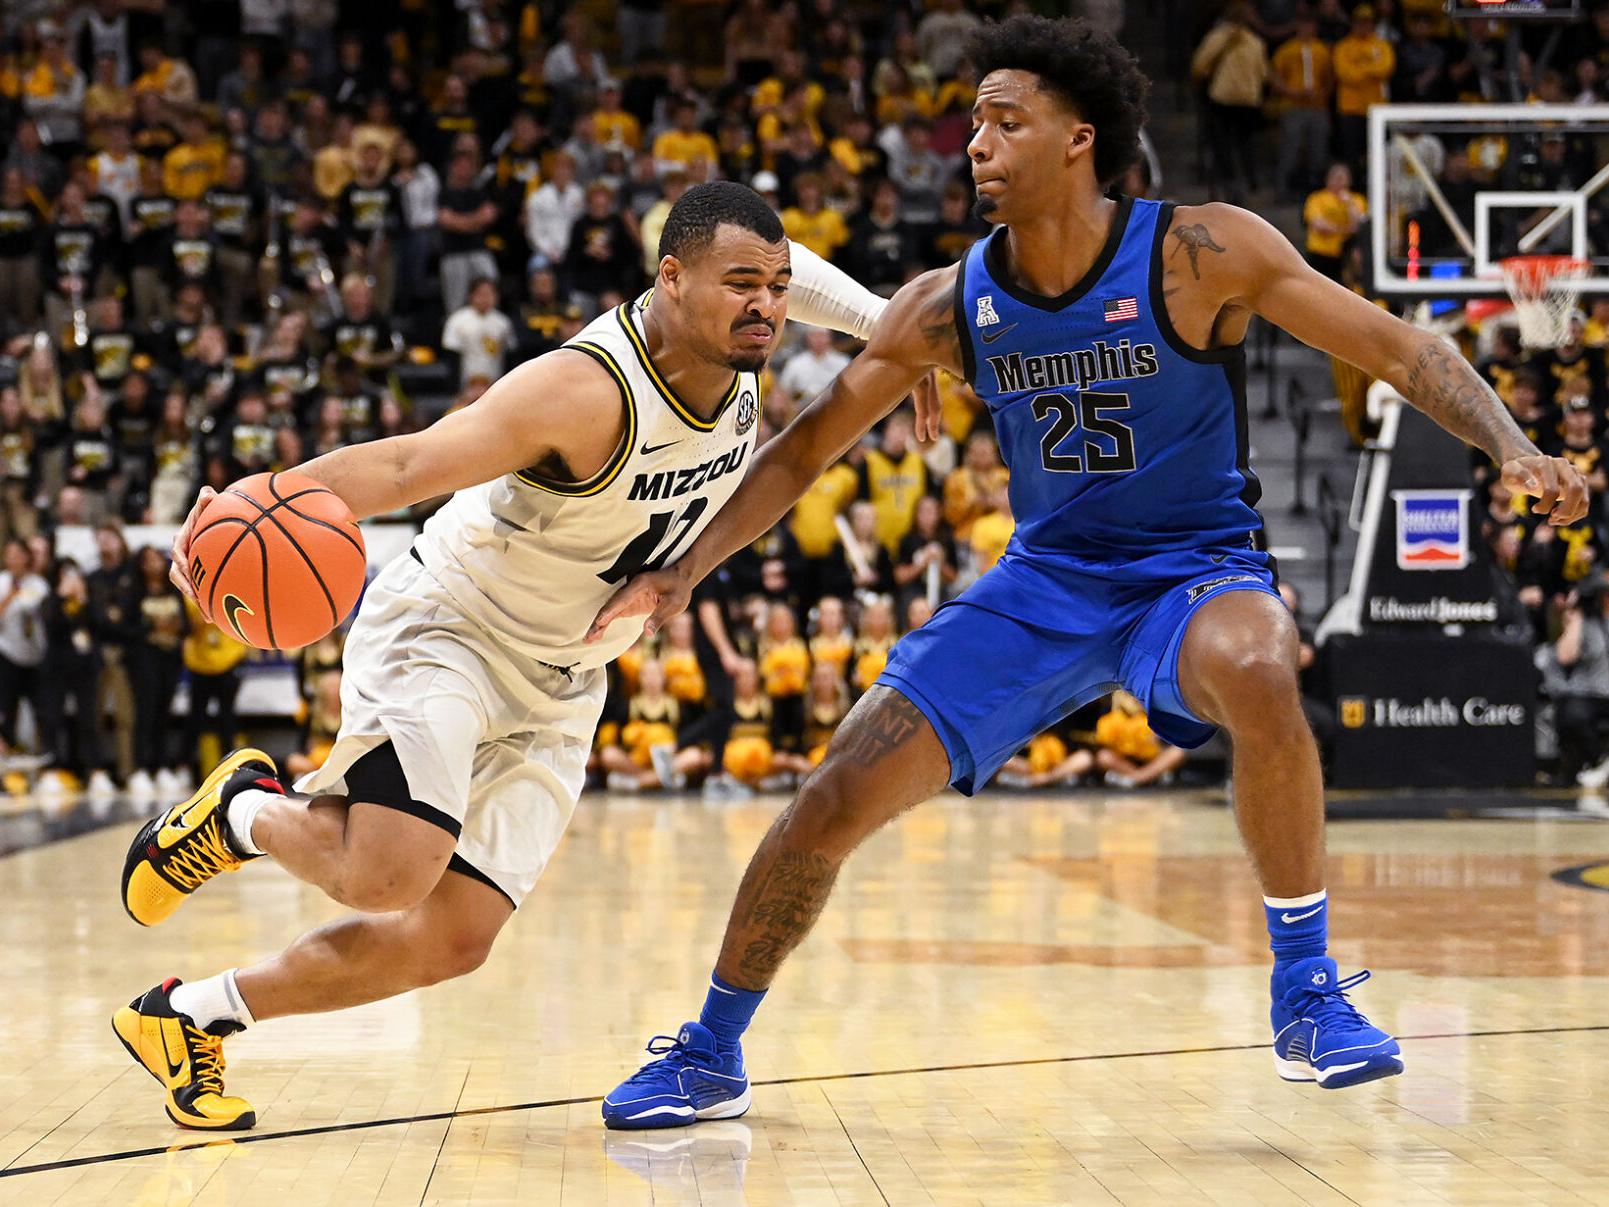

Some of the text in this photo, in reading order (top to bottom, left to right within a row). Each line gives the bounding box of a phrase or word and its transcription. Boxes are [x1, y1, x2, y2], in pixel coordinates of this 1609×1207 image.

[988, 339, 1159, 394] Memphis
[1030, 392, 1137, 474] 25
[627, 441, 749, 501] MIZZOU
[1373, 696, 1526, 726] Health Care
